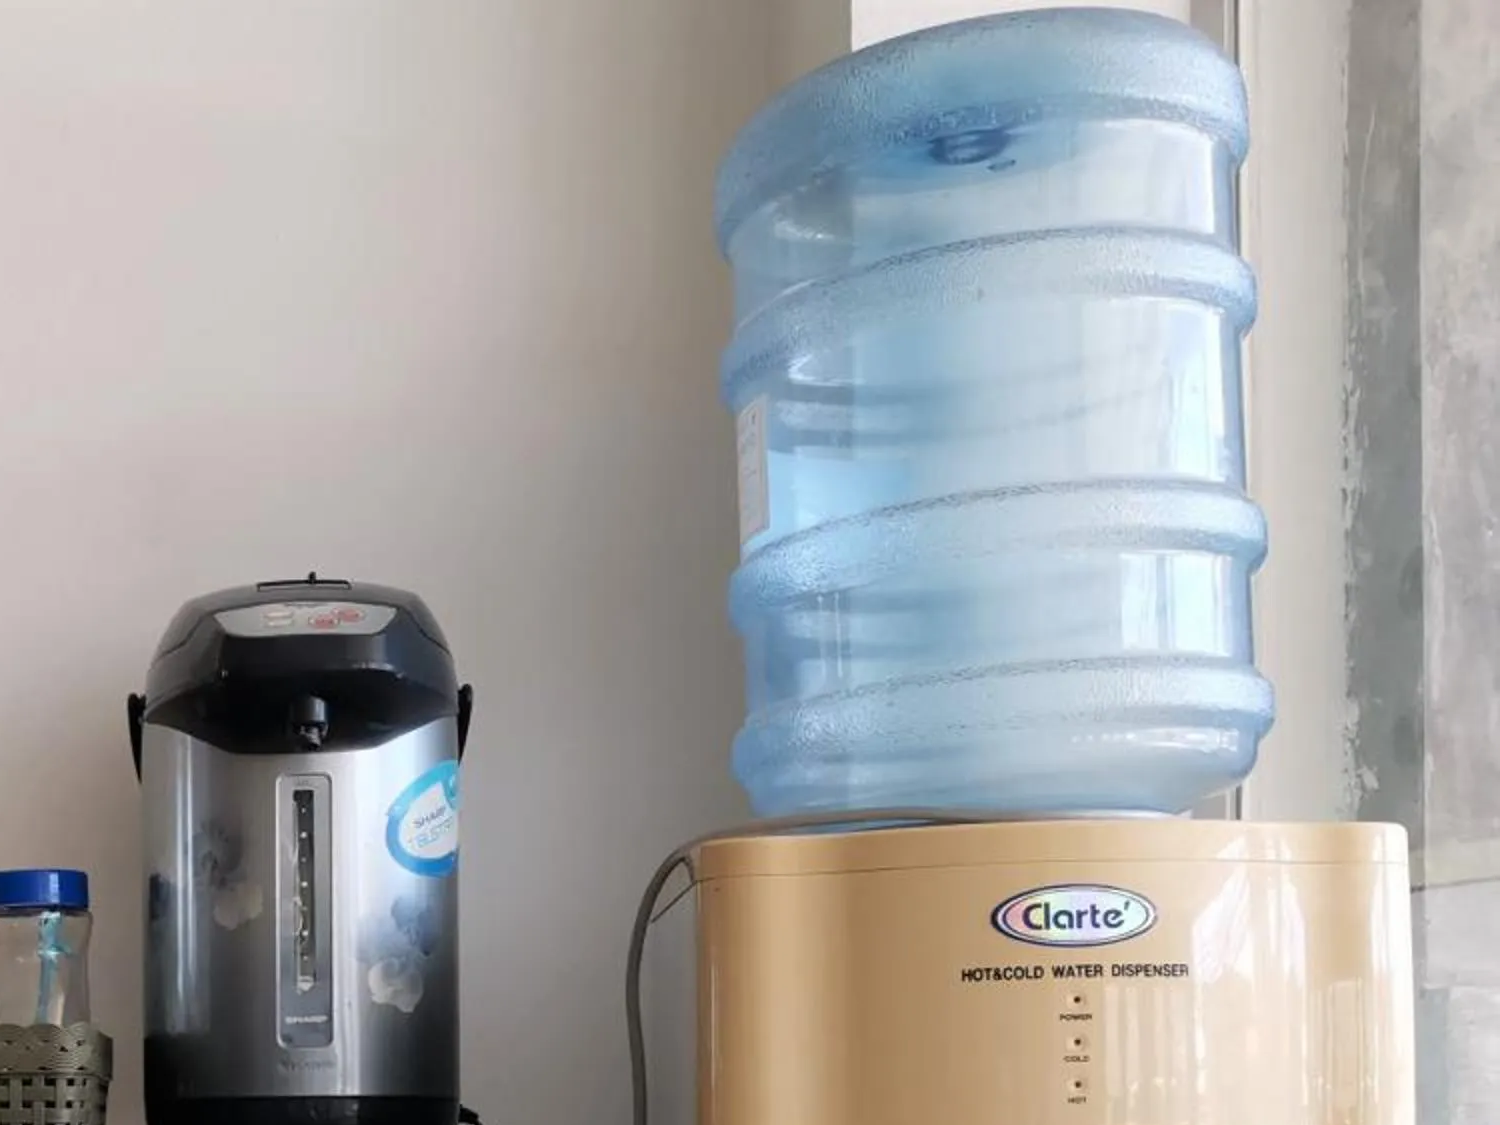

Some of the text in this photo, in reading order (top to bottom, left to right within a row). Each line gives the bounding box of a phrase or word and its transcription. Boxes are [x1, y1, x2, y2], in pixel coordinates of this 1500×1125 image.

[961, 963, 1189, 982] HOT&COLD WATER DISPENSER
[1063, 1055, 1091, 1063] COLD
[1067, 1096, 1087, 1104] HOT
